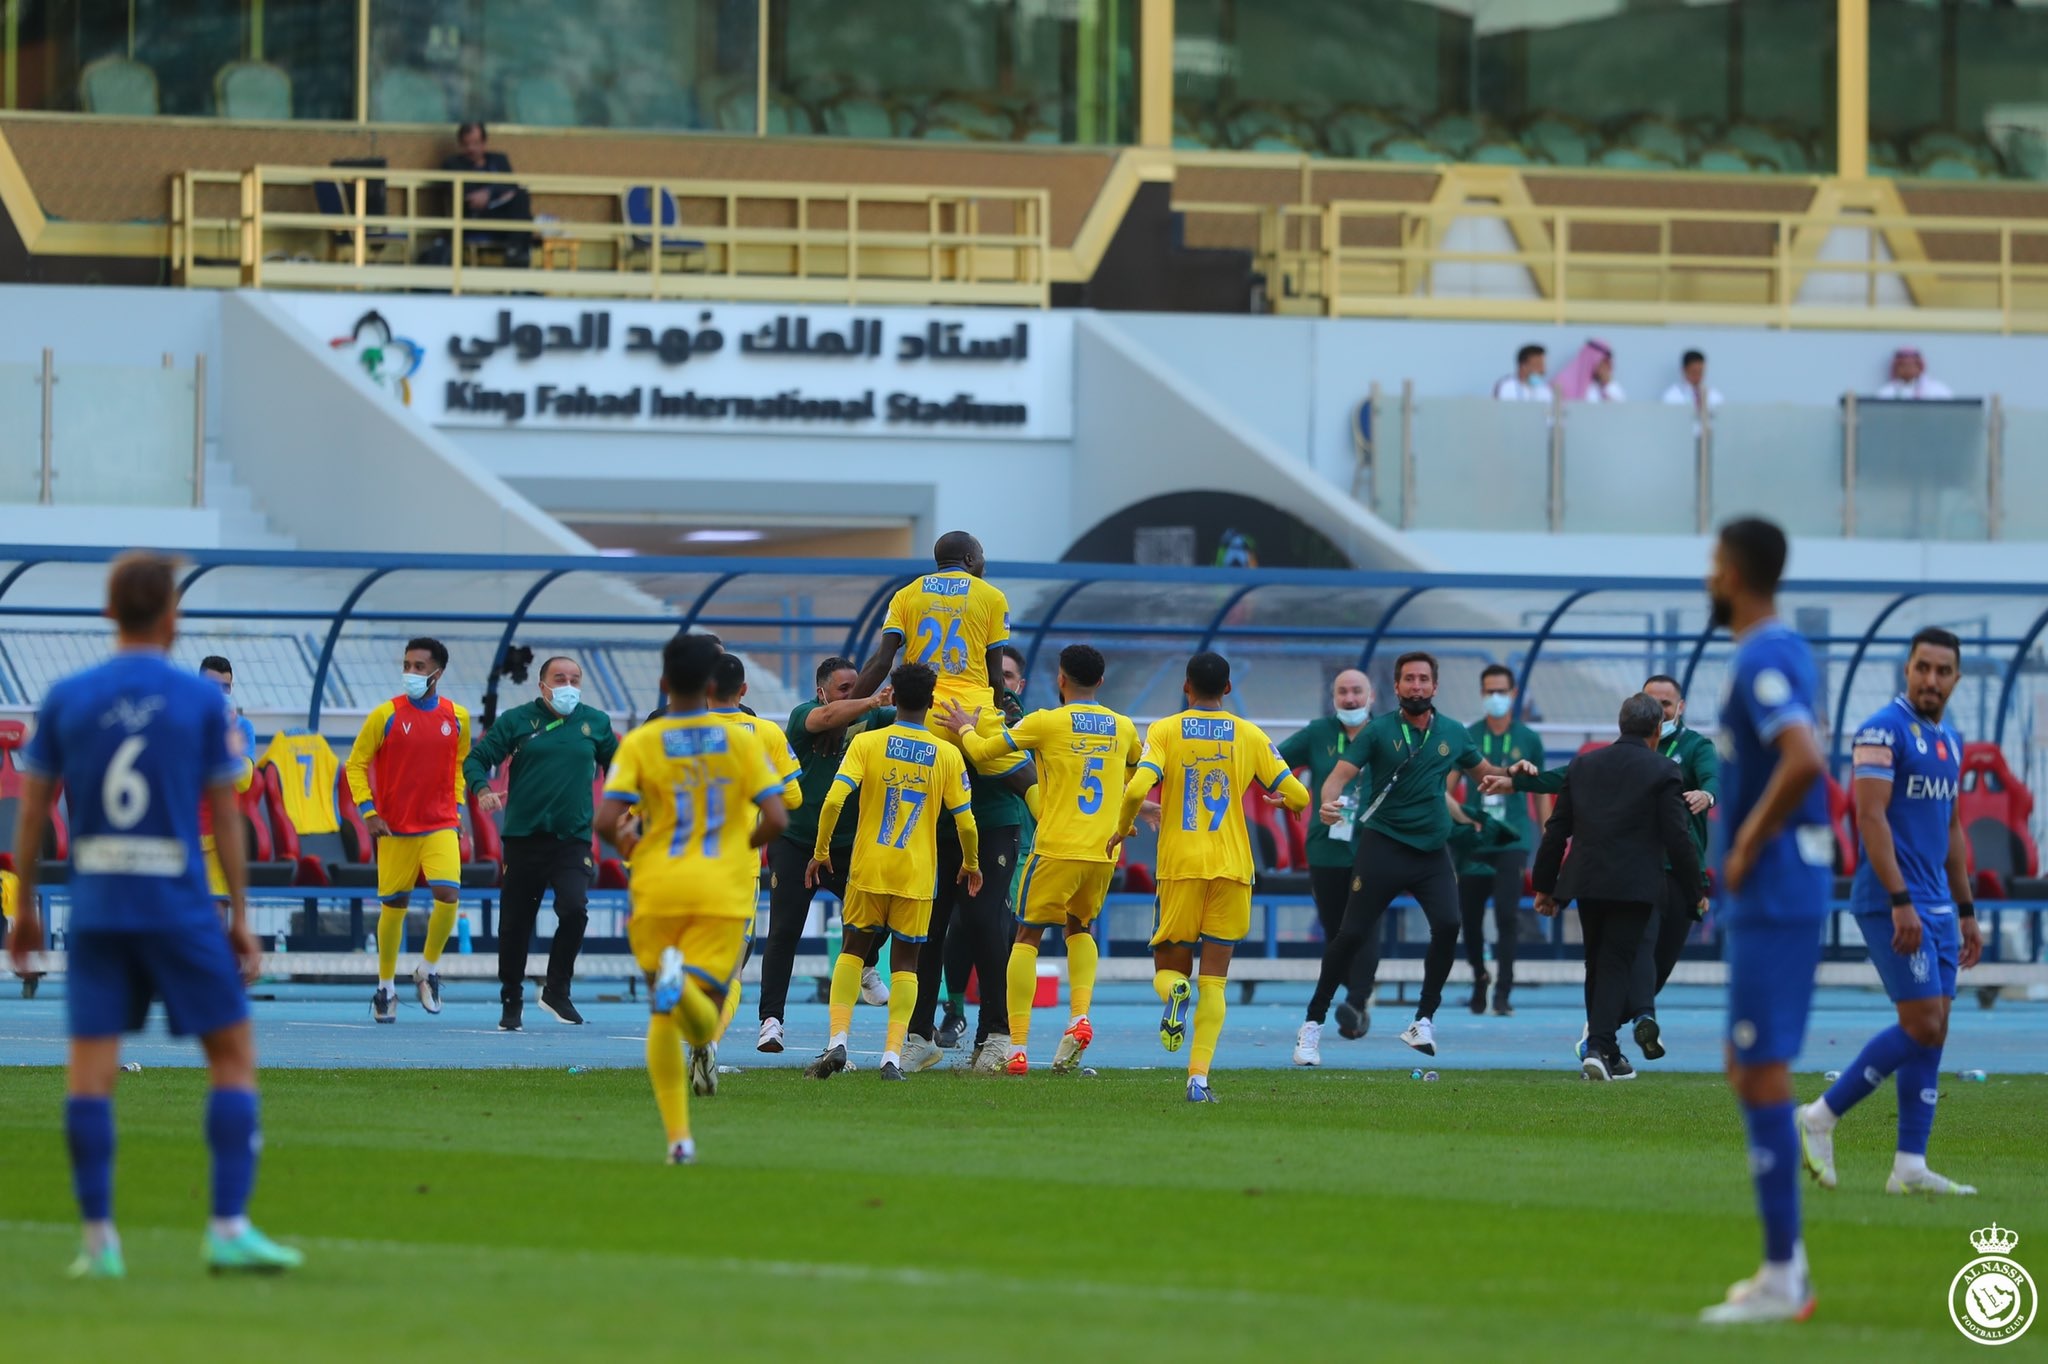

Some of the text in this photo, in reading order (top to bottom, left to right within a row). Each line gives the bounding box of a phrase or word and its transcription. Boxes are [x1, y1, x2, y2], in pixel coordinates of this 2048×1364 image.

[447, 310, 610, 371] الدولي
[624, 311, 724, 366] فهد
[740, 316, 883, 358] الملك
[445, 380, 1027, 425] King Fahad International Stadium
[923, 583, 944, 593] YOU
[917, 616, 969, 675] 26
[887, 745, 909, 759] YOU
[1073, 720, 1093, 731] YOU
[1183, 726, 1206, 737] YOU
[102, 733, 150, 831] 6
[297, 754, 313, 798] 7
[1077, 757, 1104, 815] 5
[1181, 768, 1230, 832] 19
[668, 784, 726, 858] 11
[876, 786, 928, 850] 17
